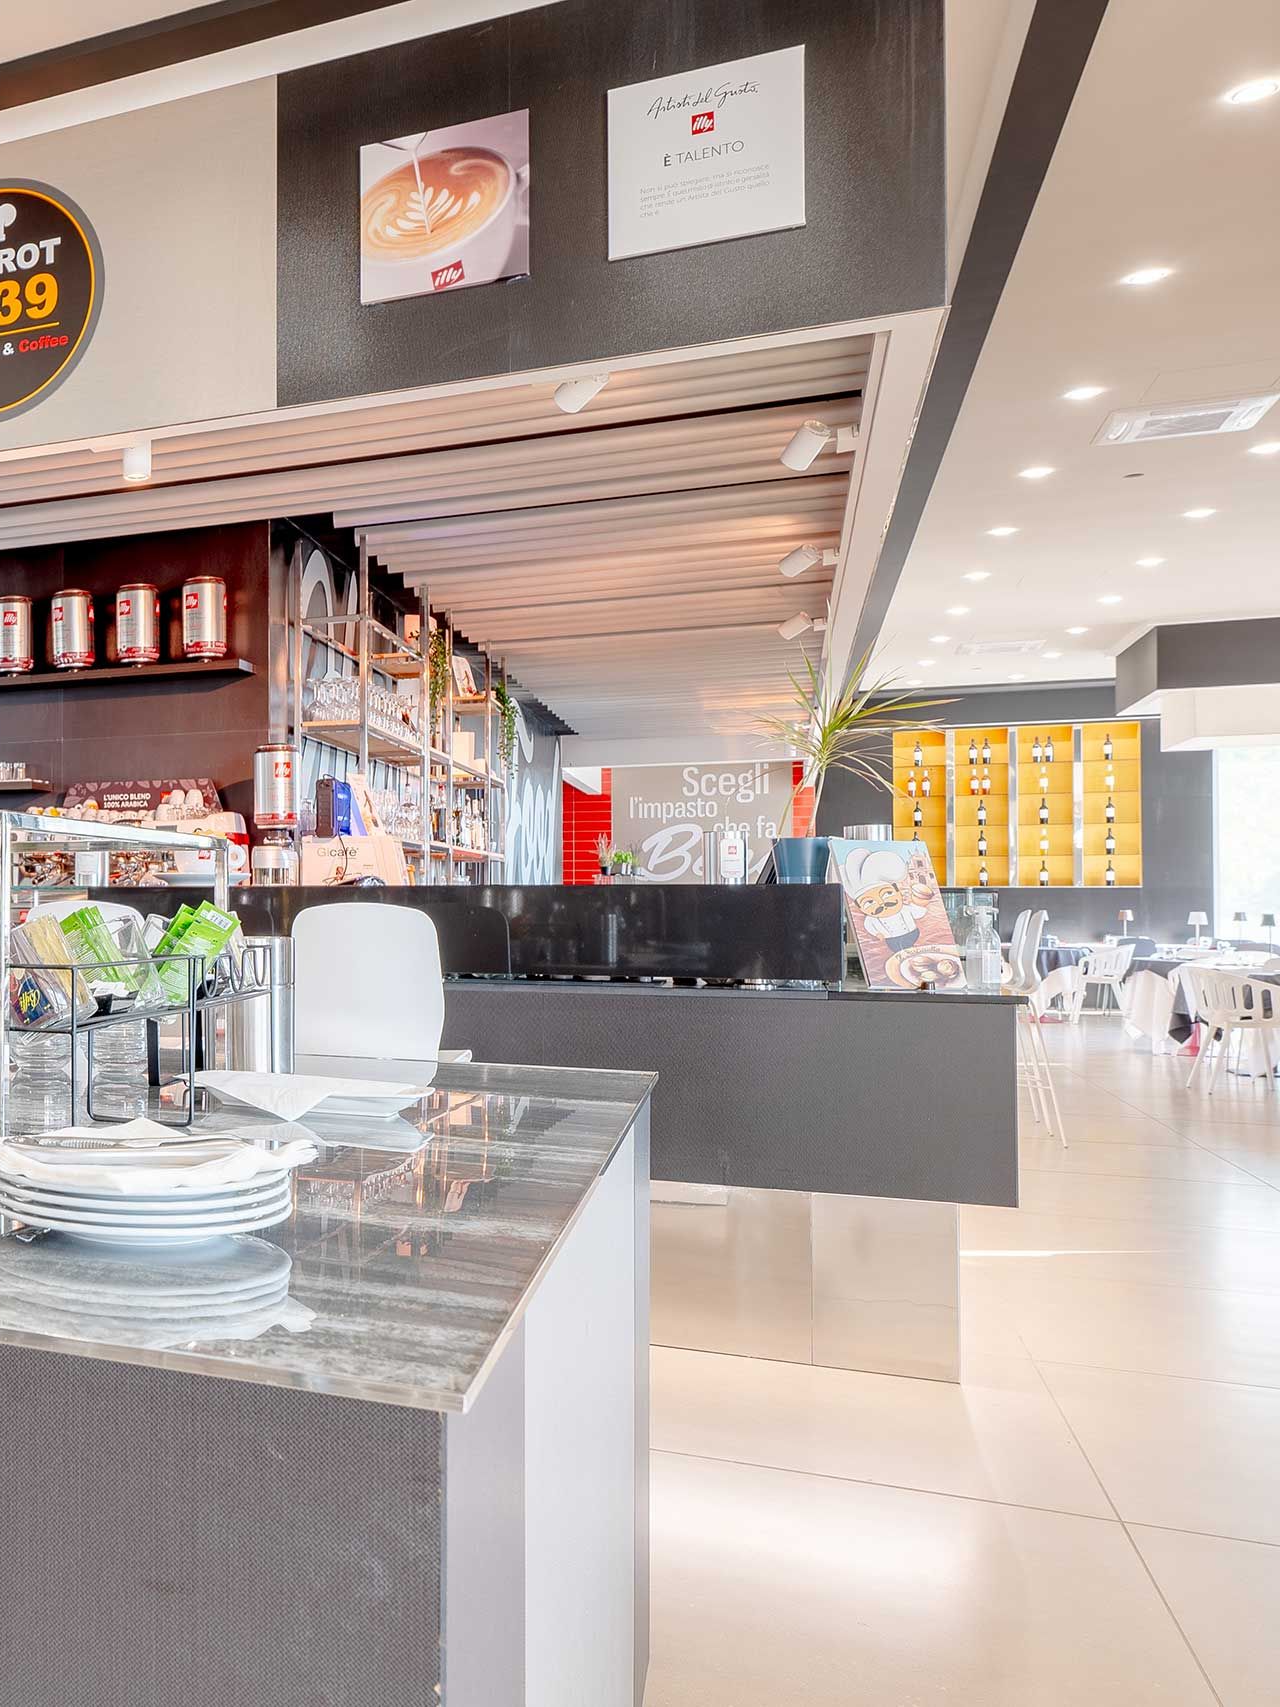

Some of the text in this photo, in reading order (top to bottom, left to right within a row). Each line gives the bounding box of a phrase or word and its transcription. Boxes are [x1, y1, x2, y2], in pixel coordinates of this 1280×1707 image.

[647, 95, 692, 119] Artisti
[692, 88, 713, 107] del
[693, 115, 713, 132] illy
[663, 140, 745, 167] È TALENTO
[434, 266, 463, 287] illy
[3, 342, 15, 356] &
[19, 335, 69, 352] Coffee
[682, 763, 769, 803] Scegli
[103, 800, 149, 809] 100% ARABICA
[130, 793, 152, 801] BLEND
[757, 815, 777, 839] fa
